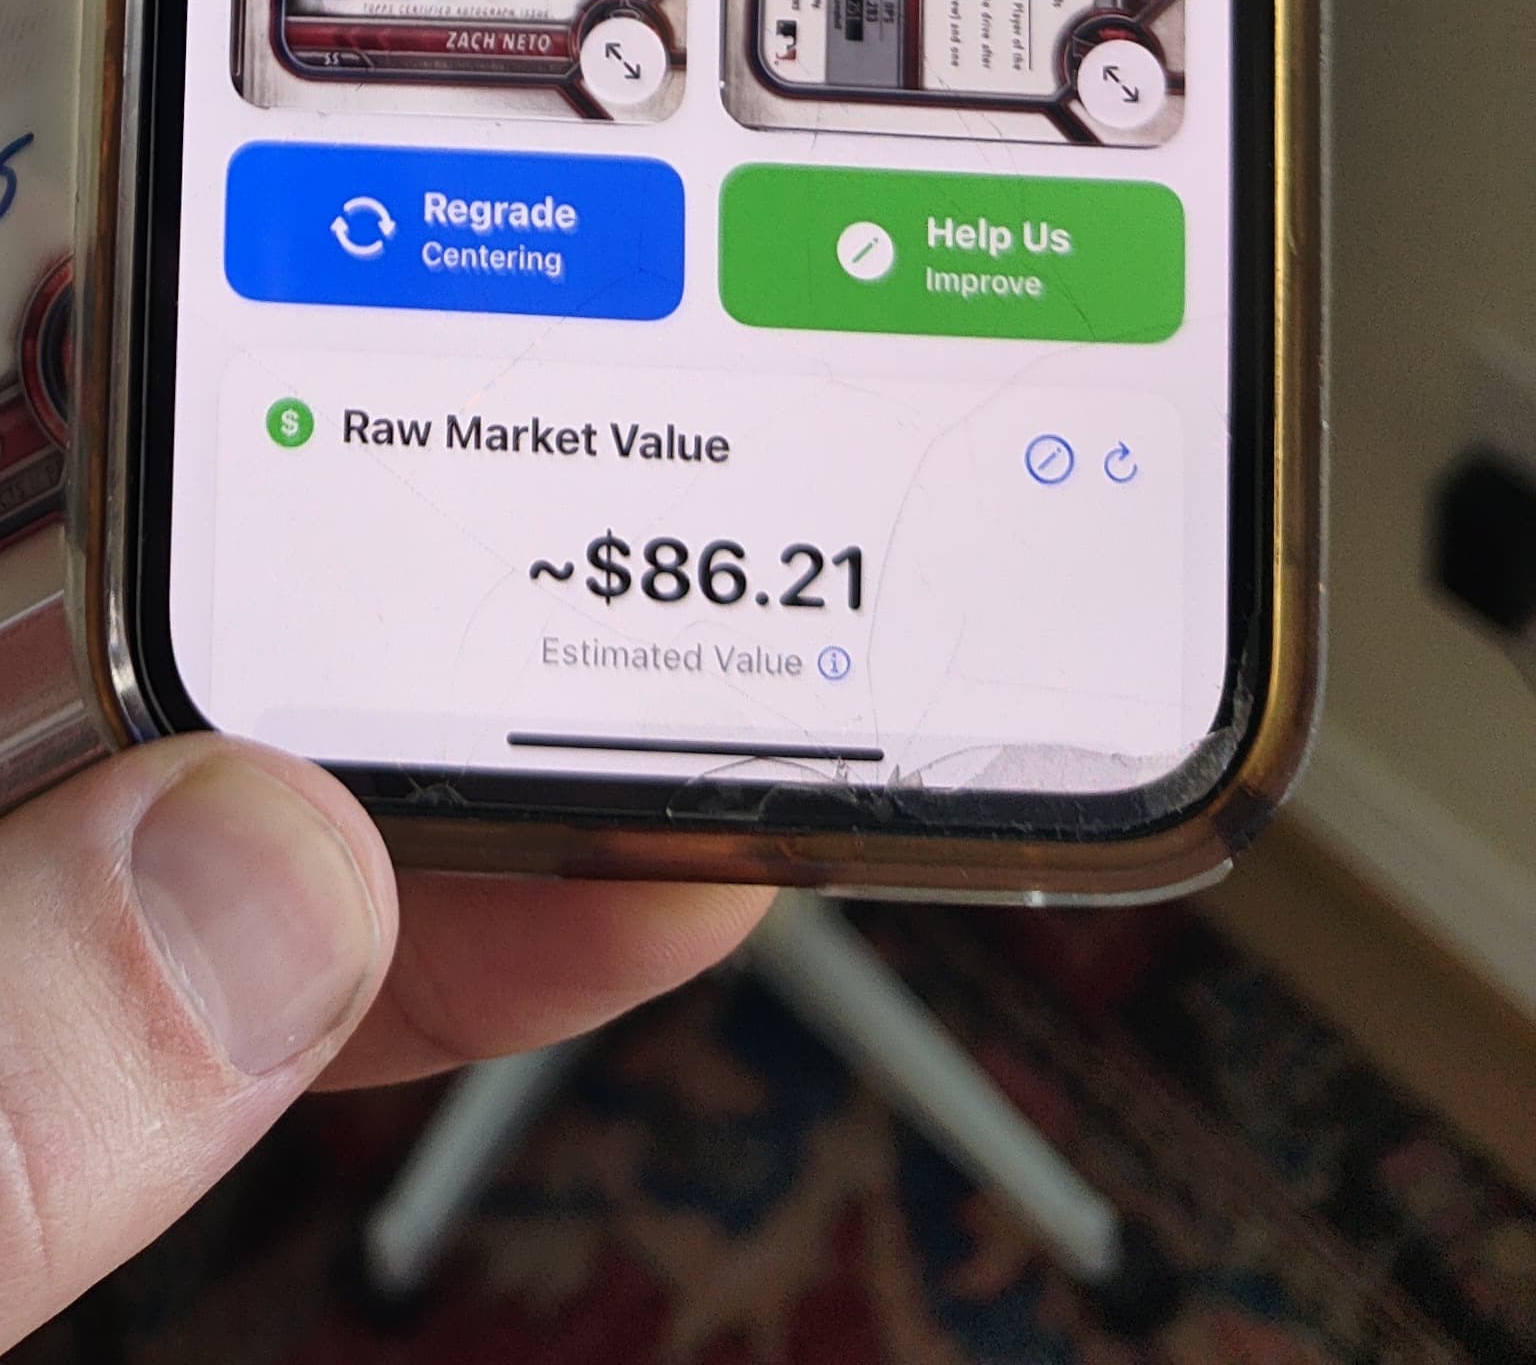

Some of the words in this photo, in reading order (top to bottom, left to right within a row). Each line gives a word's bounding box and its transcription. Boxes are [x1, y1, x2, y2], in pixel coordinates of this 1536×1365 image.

[1009, 2, 1024, 36] Player
[446, 31, 495, 50] ZACH
[503, 34, 552, 53] NETO
[981, 43, 993, 69] after
[423, 191, 578, 234] Regrade
[926, 215, 1013, 258] Help
[1022, 220, 1072, 255] Us
[421, 240, 564, 279] Centering
[925, 265, 1044, 299] Improve
[342, 408, 433, 449] Raw
[445, 413, 599, 458] Market
[609, 422, 731, 465] Value
[528, 528, 864, 612] ~$86.21
[541, 636, 703, 673] Estimated
[713, 644, 804, 678] Value
